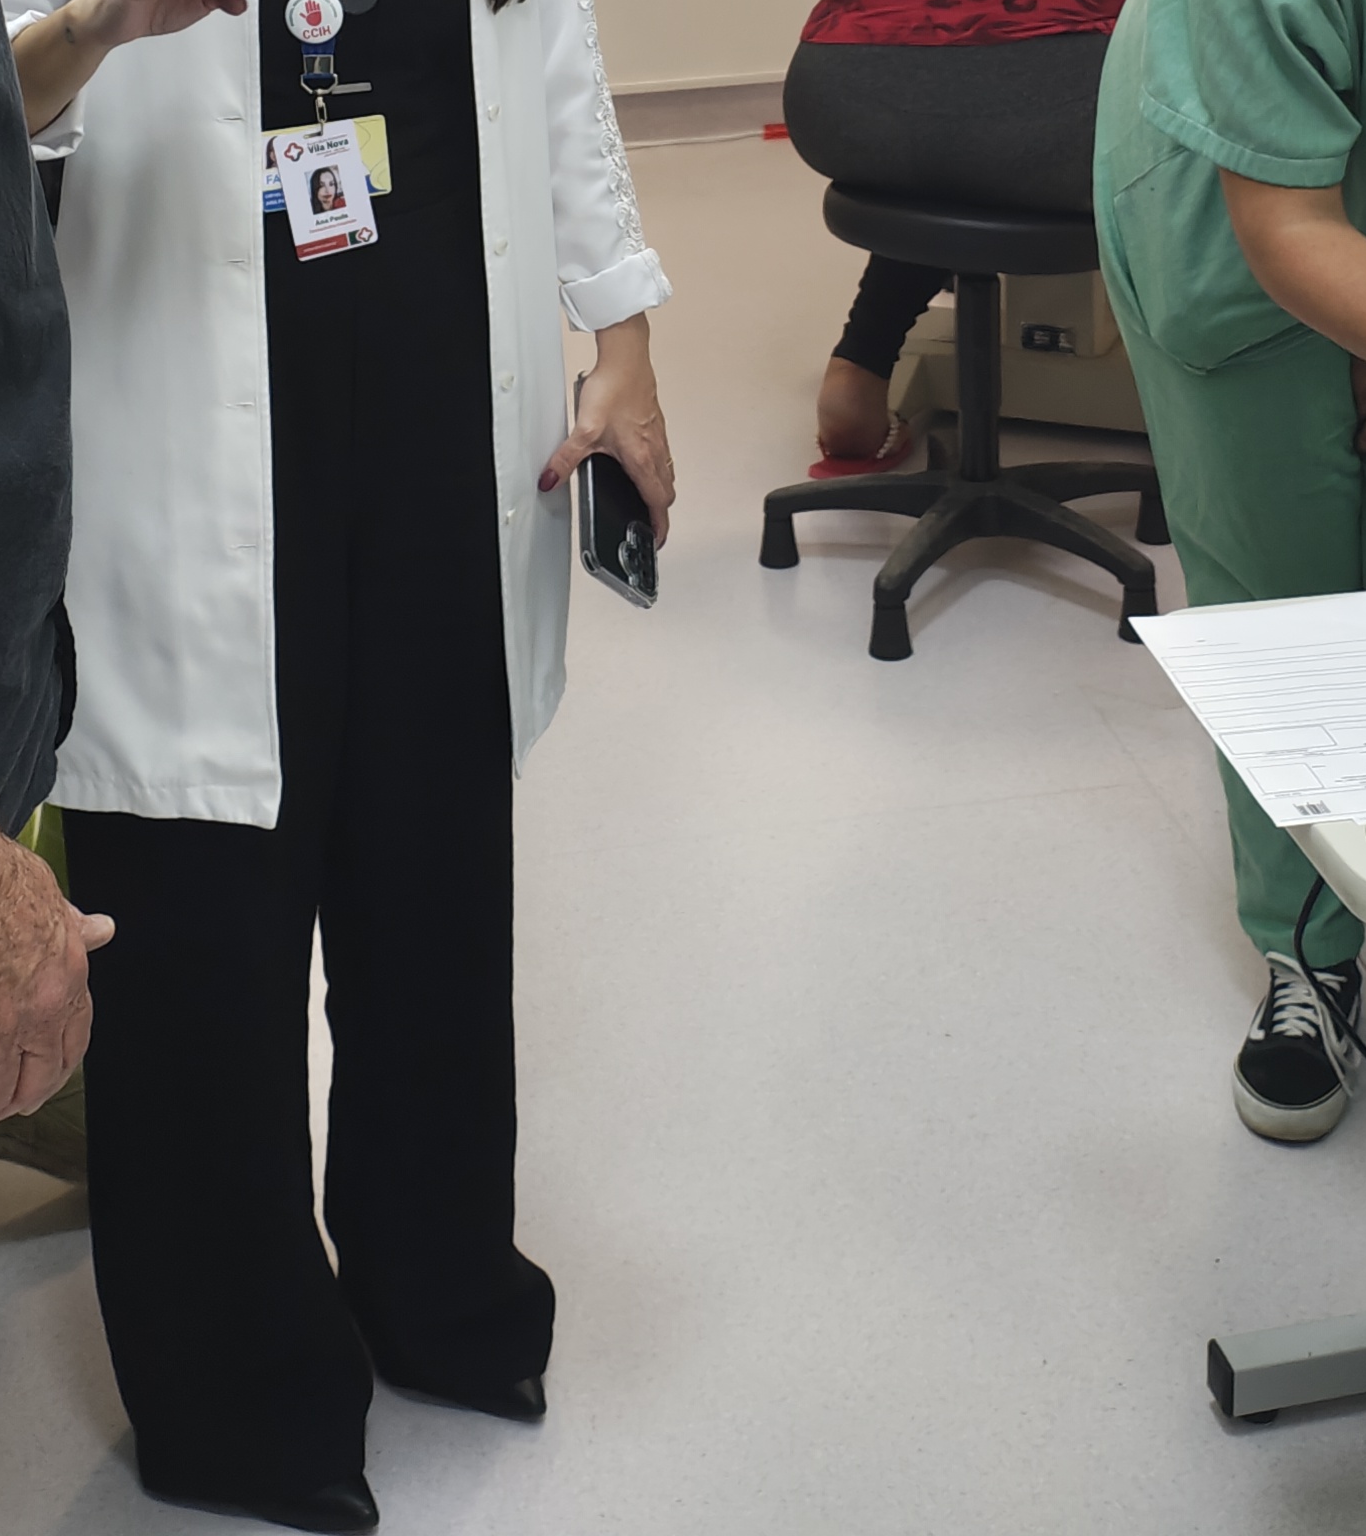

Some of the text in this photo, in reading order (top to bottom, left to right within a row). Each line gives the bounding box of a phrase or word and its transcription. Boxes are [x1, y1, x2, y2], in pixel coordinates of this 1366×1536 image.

[302, 25, 332, 40] CCIH
[307, 144, 325, 154] Vila
[327, 138, 349, 150] Nova
